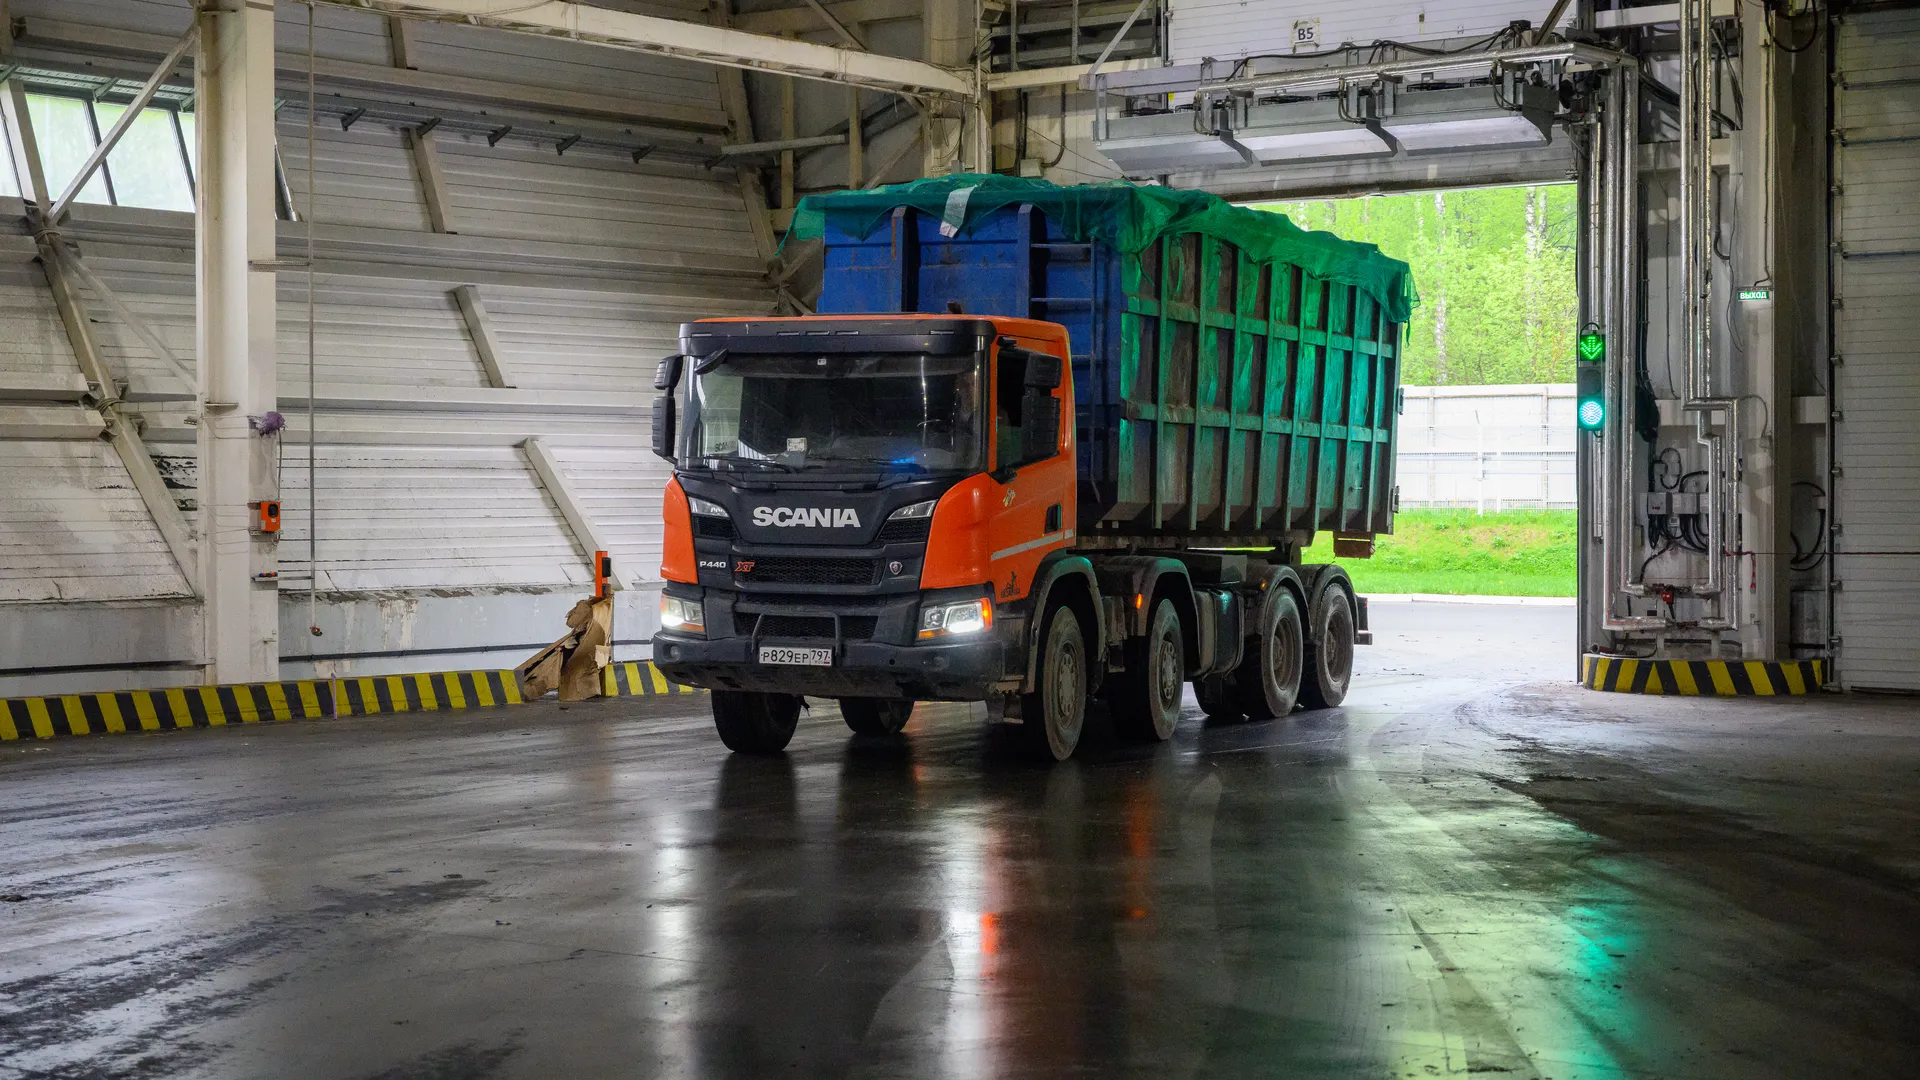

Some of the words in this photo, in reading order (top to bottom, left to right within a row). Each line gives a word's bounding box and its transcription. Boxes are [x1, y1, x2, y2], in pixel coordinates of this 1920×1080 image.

[1740, 291, 1768, 300] ВЫХОД
[752, 506, 861, 528] SCANIA
[699, 560, 727, 569] P440
[734, 561, 756, 573] XT
